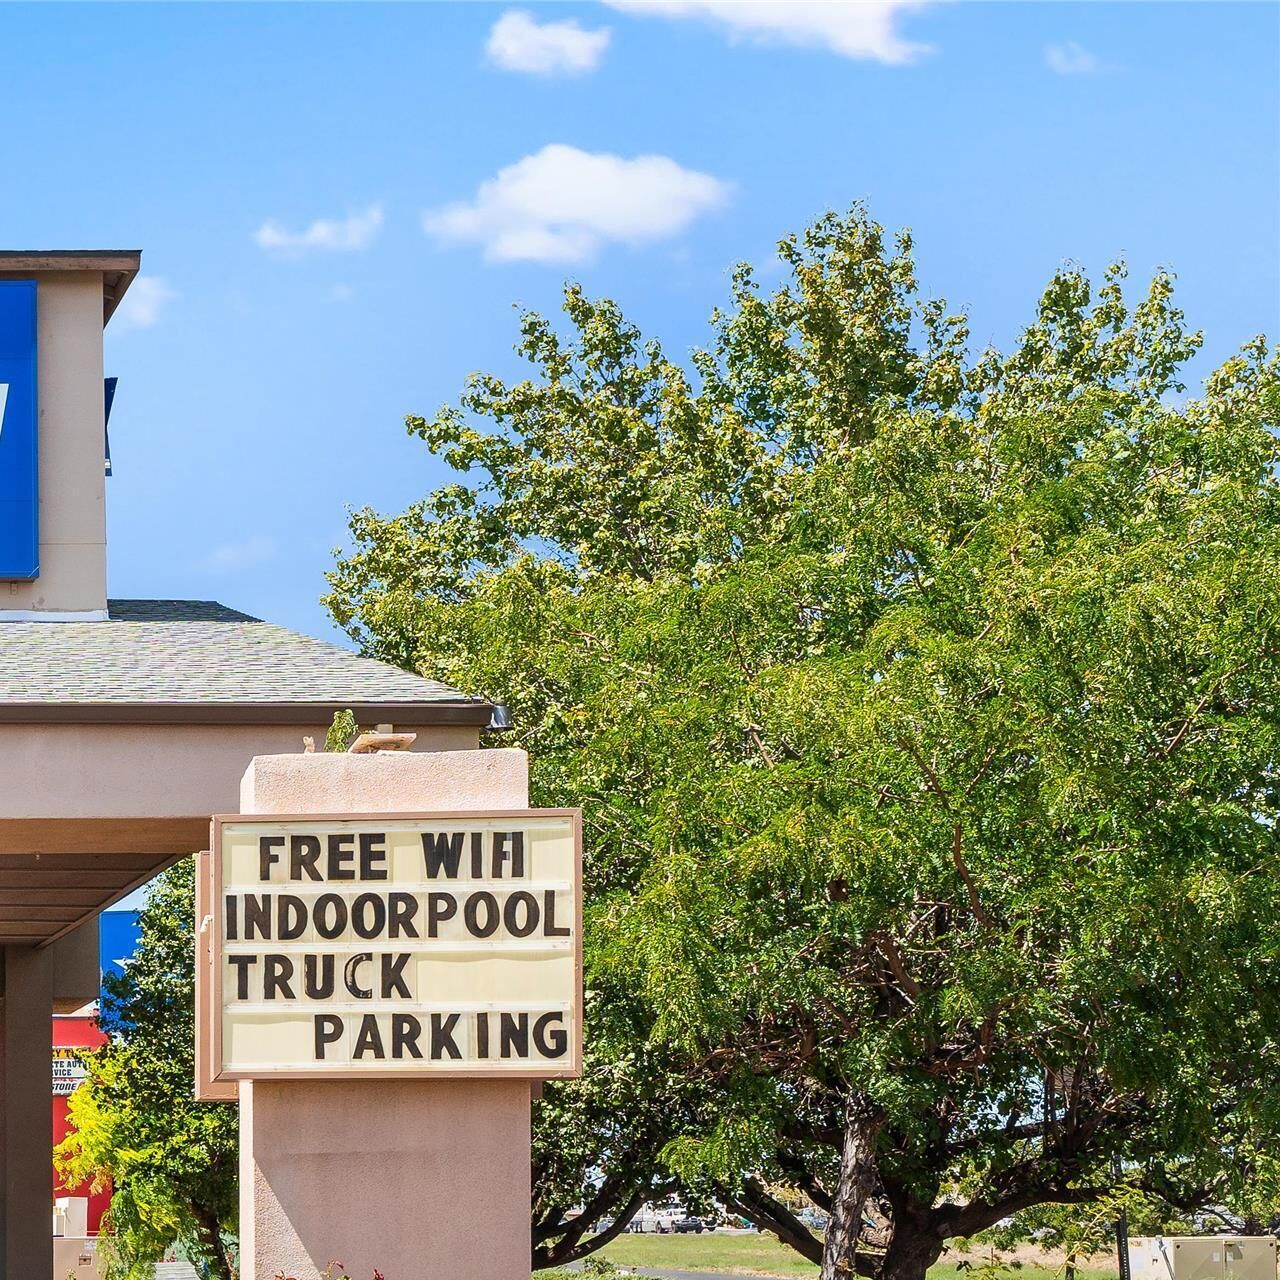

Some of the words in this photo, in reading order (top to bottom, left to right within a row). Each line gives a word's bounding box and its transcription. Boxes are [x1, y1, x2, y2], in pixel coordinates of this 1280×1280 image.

[260, 833, 387, 881] FREE
[229, 953, 411, 999] TRUCK
[315, 1012, 567, 1059] PARKING
